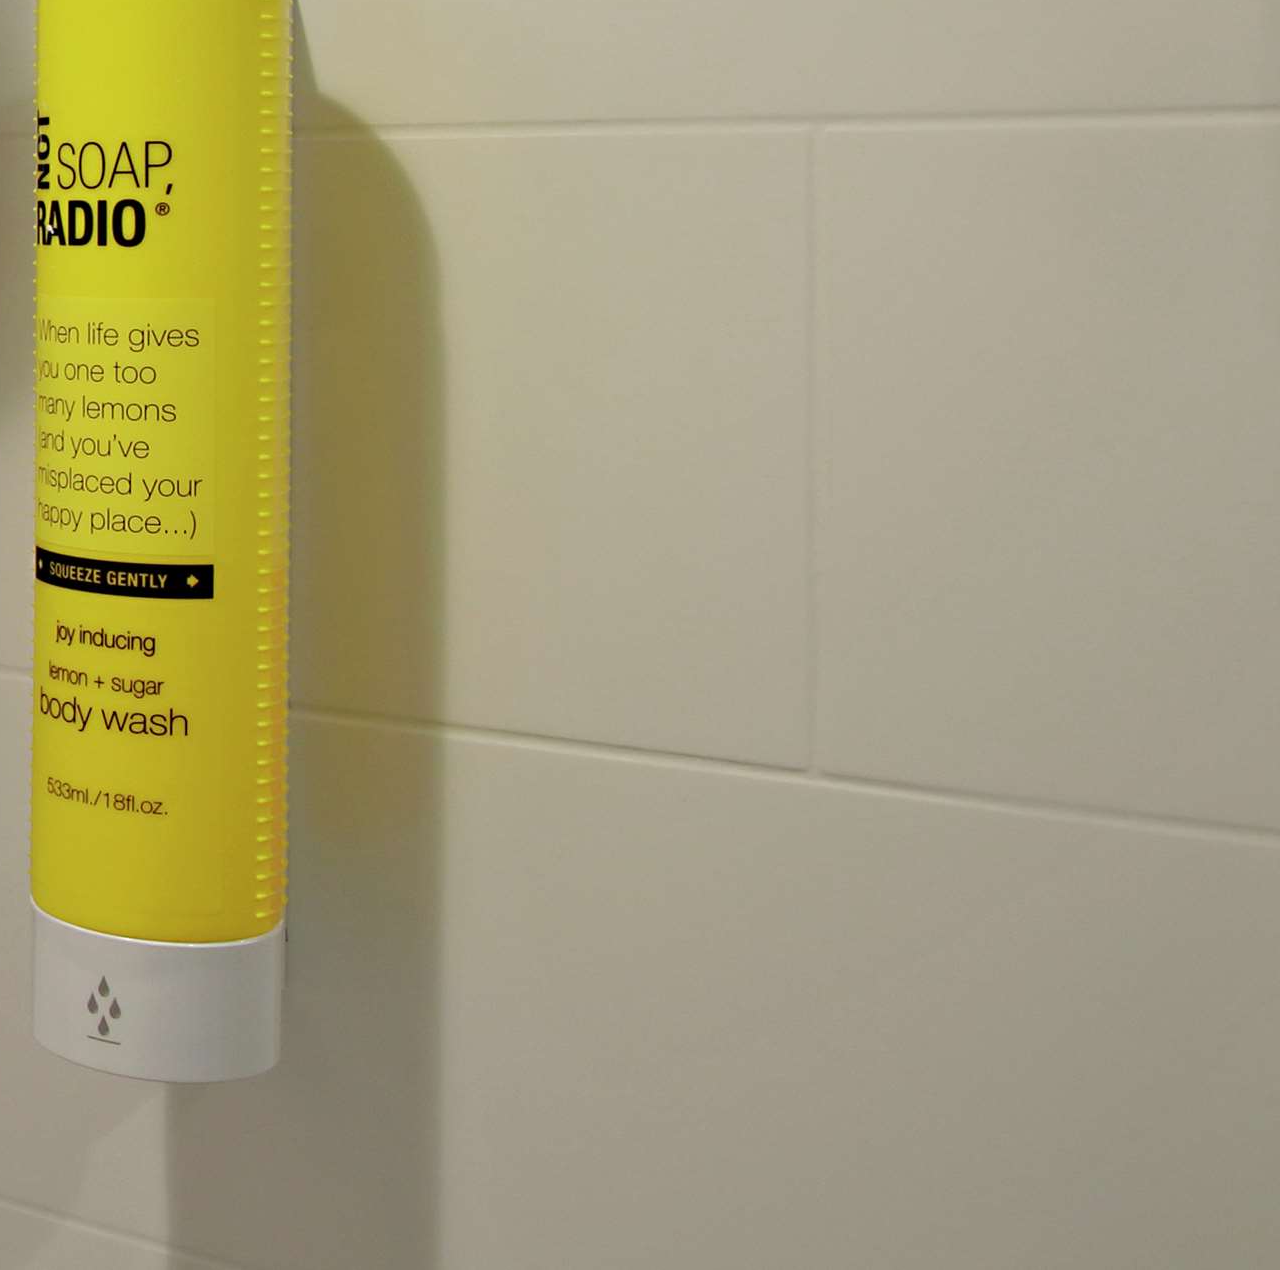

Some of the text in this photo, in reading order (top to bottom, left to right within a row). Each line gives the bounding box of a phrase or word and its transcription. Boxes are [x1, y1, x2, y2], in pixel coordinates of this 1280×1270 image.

[57, 140, 174, 195] SOAP,
[87, 321, 119, 346] life
[128, 323, 200, 353] gives
[64, 362, 104, 383] one
[113, 361, 157, 385] too
[82, 395, 177, 423] lemons
[40, 429, 150, 459] and you've
[142, 478, 203, 502] your
[90, 507, 197, 540] place...)
[49, 560, 168, 589] SQUEEZE GENTLY
[56, 619, 156, 657] joy inducing
[48, 659, 88, 687] lemon
[111, 676, 165, 699] sugar
[40, 685, 189, 737] body wash
[47, 776, 169, 816] 533ml./18fl.oz.
